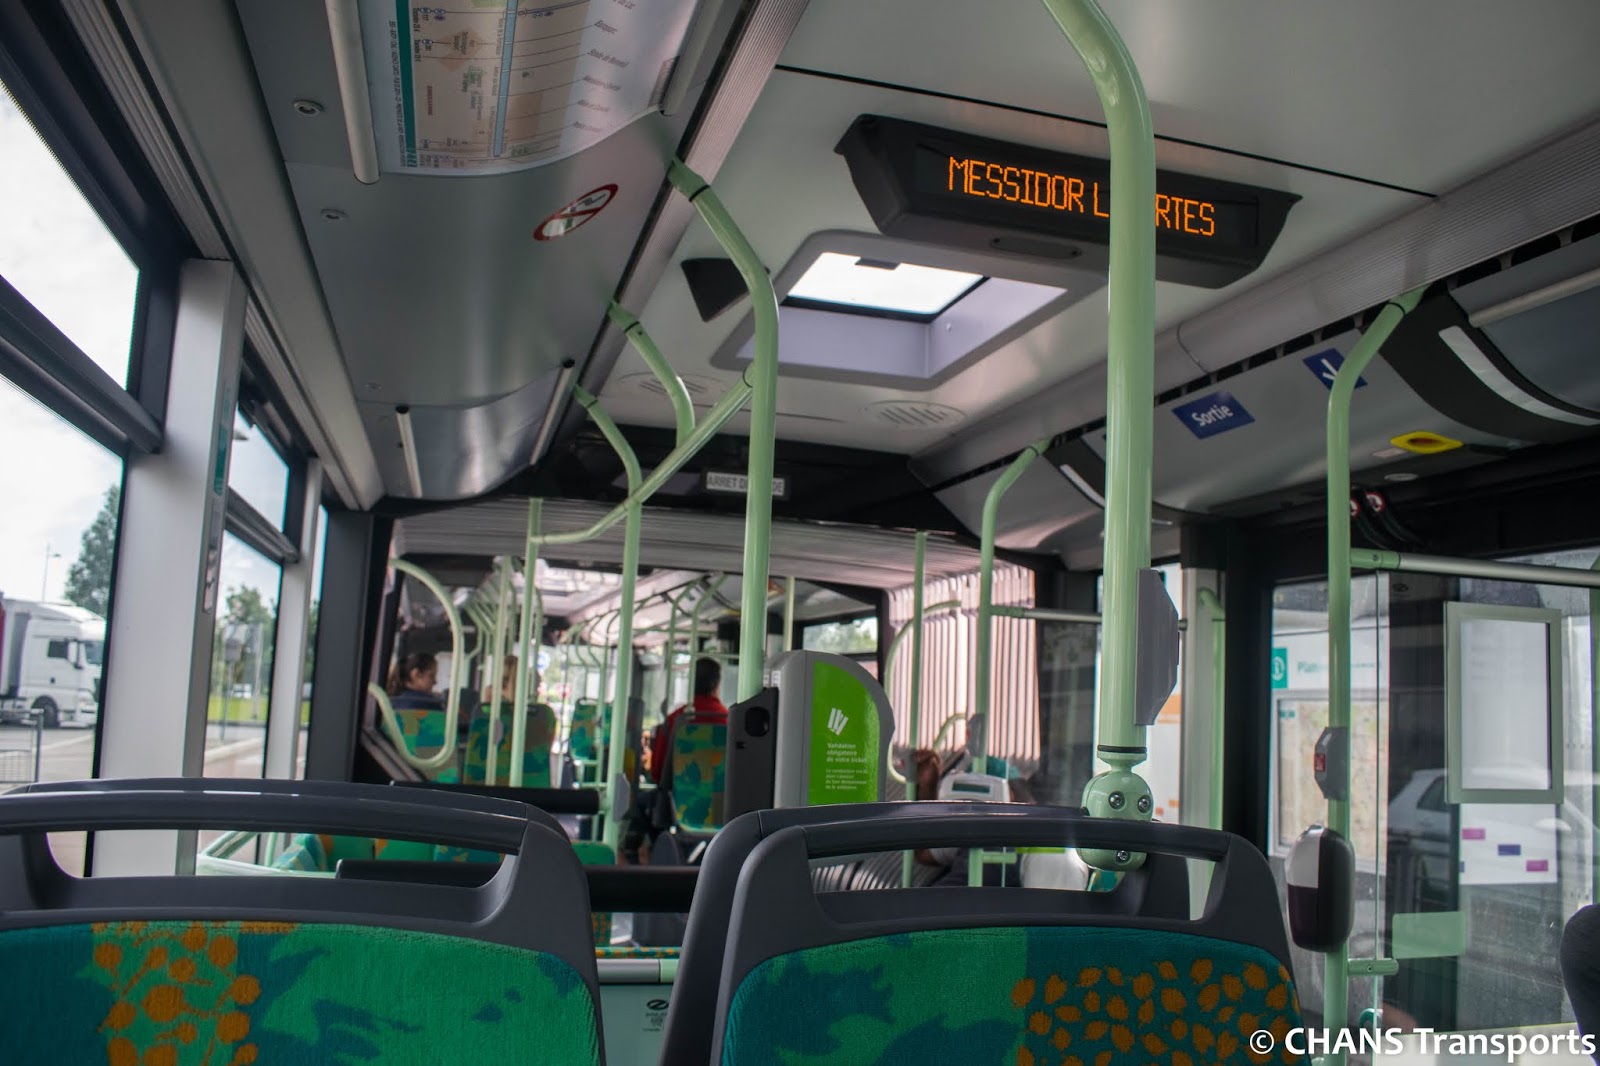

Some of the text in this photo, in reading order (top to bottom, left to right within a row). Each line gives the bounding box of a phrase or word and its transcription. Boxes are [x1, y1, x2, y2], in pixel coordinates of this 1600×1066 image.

[949, 156, 1215, 237] MESSIDOR LRTES
[1192, 404, 1234, 426] Sortie
[708, 475, 737, 488] ARRET
